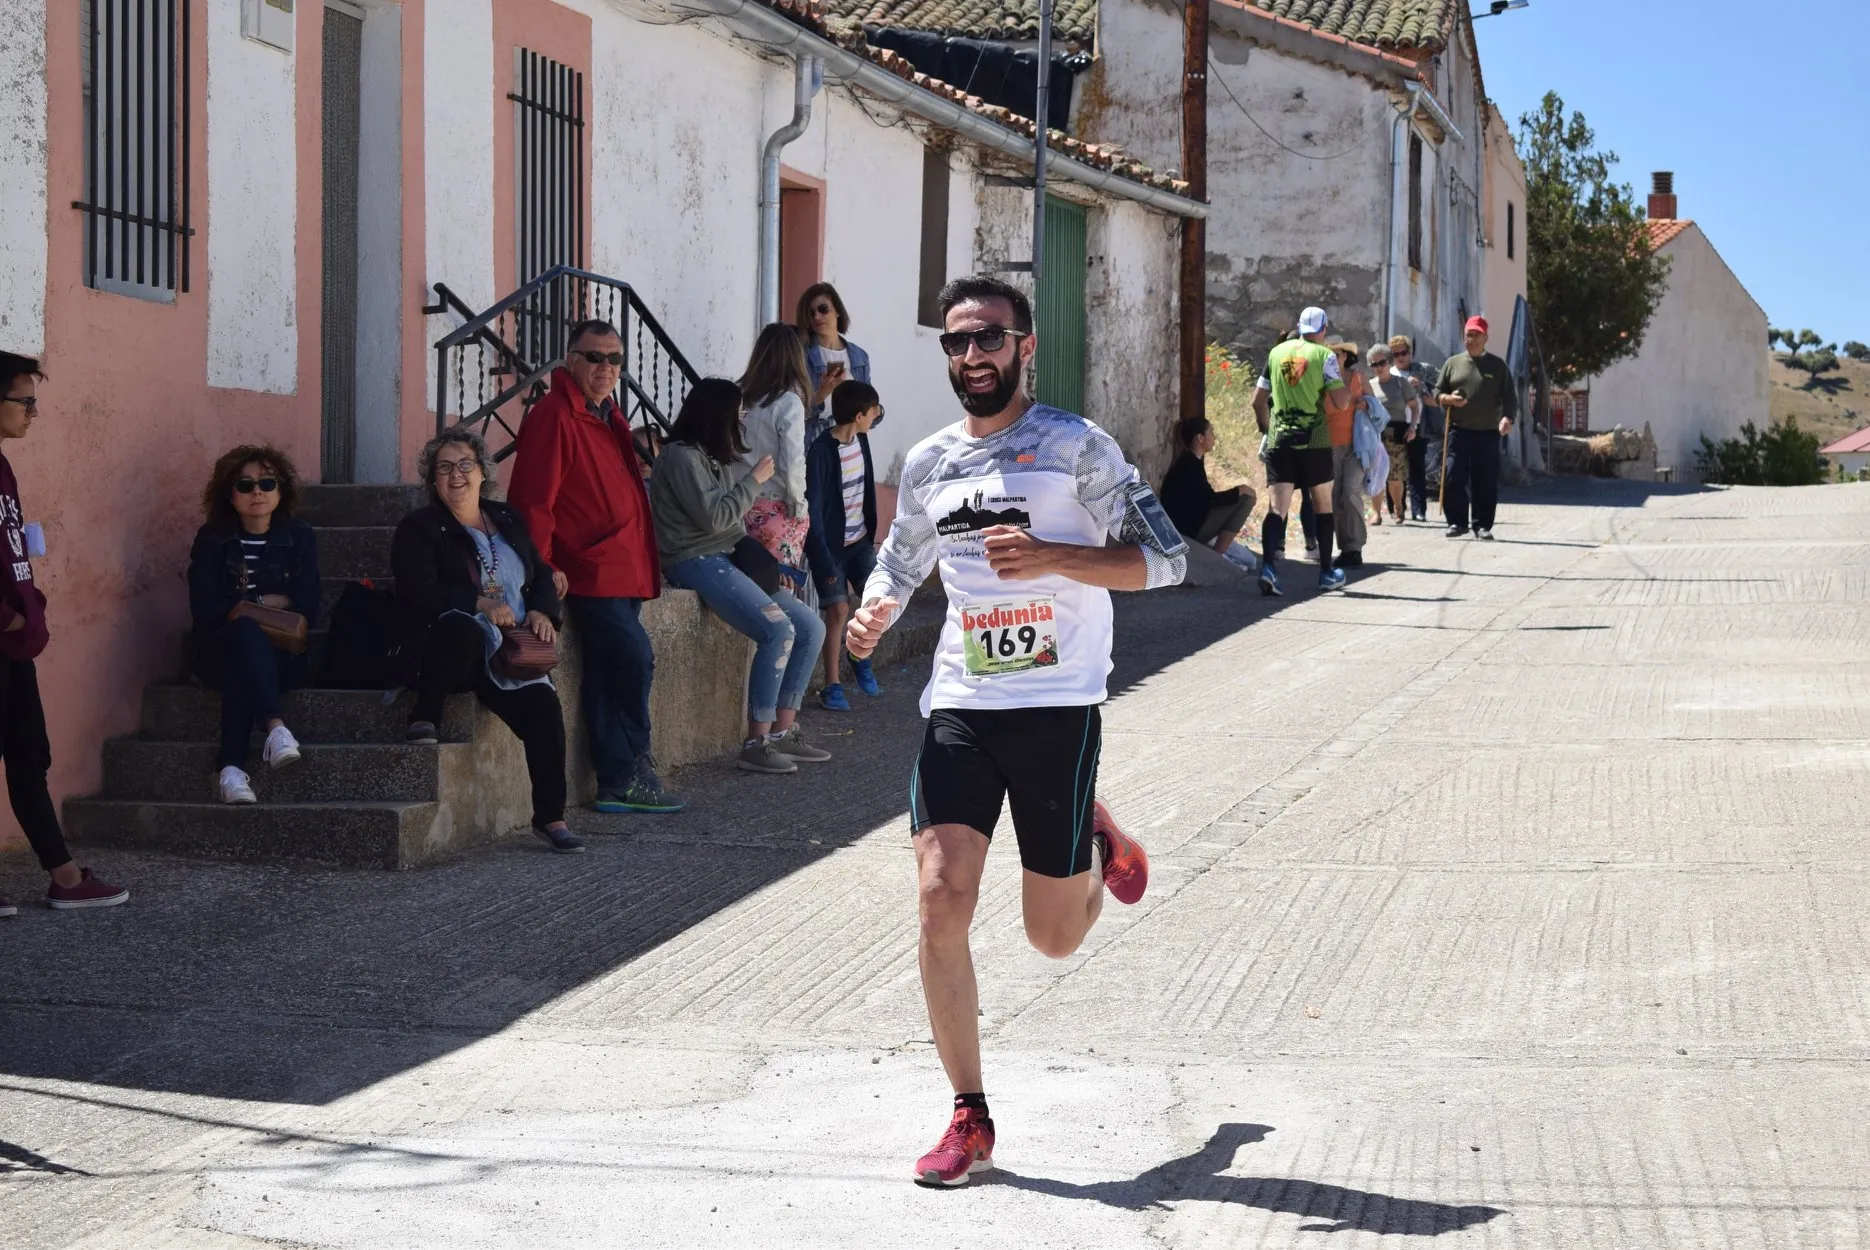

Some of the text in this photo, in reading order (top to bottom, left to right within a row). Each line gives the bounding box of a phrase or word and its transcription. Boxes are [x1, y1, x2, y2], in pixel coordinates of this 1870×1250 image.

[939, 523, 971, 533] MALPARTIDA
[962, 603, 1053, 631] bedunia
[981, 626, 1036, 658] 169
